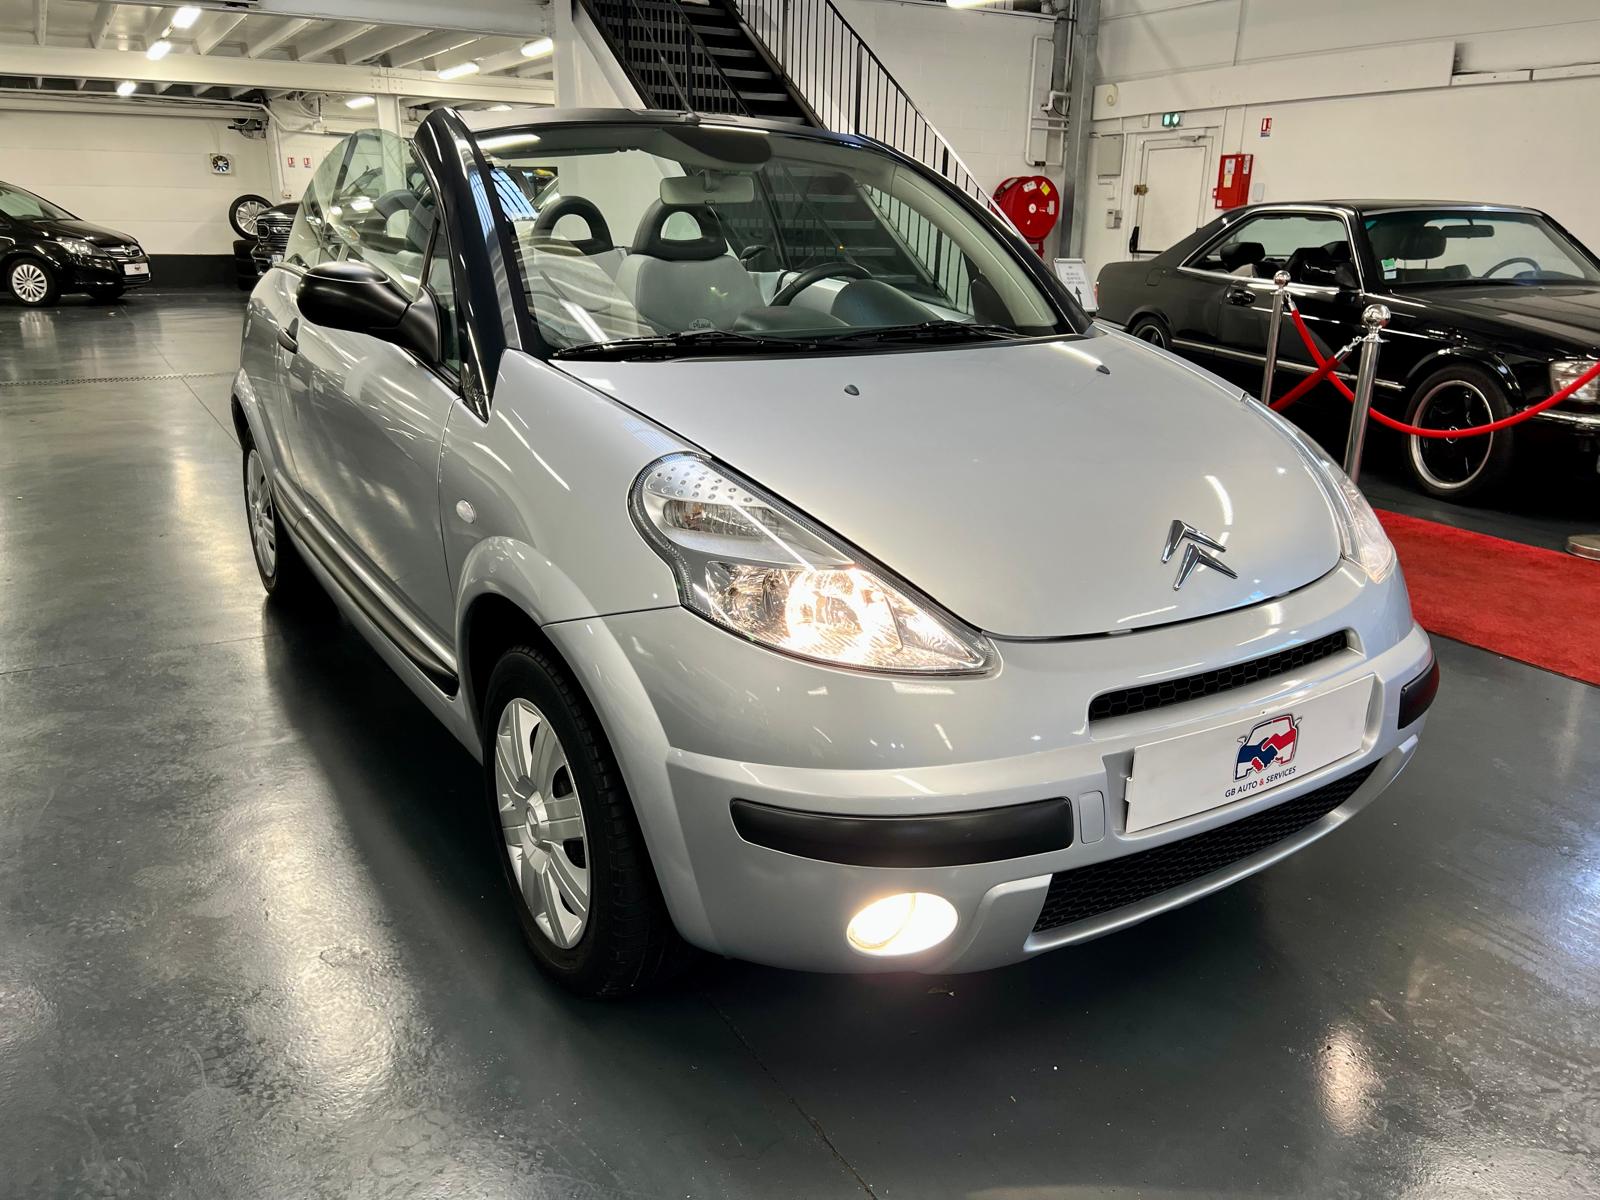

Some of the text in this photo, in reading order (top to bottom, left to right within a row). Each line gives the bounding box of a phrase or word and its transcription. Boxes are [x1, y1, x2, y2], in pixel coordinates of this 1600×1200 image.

[1225, 766, 1296, 797] GB AUTO & SERVICES
